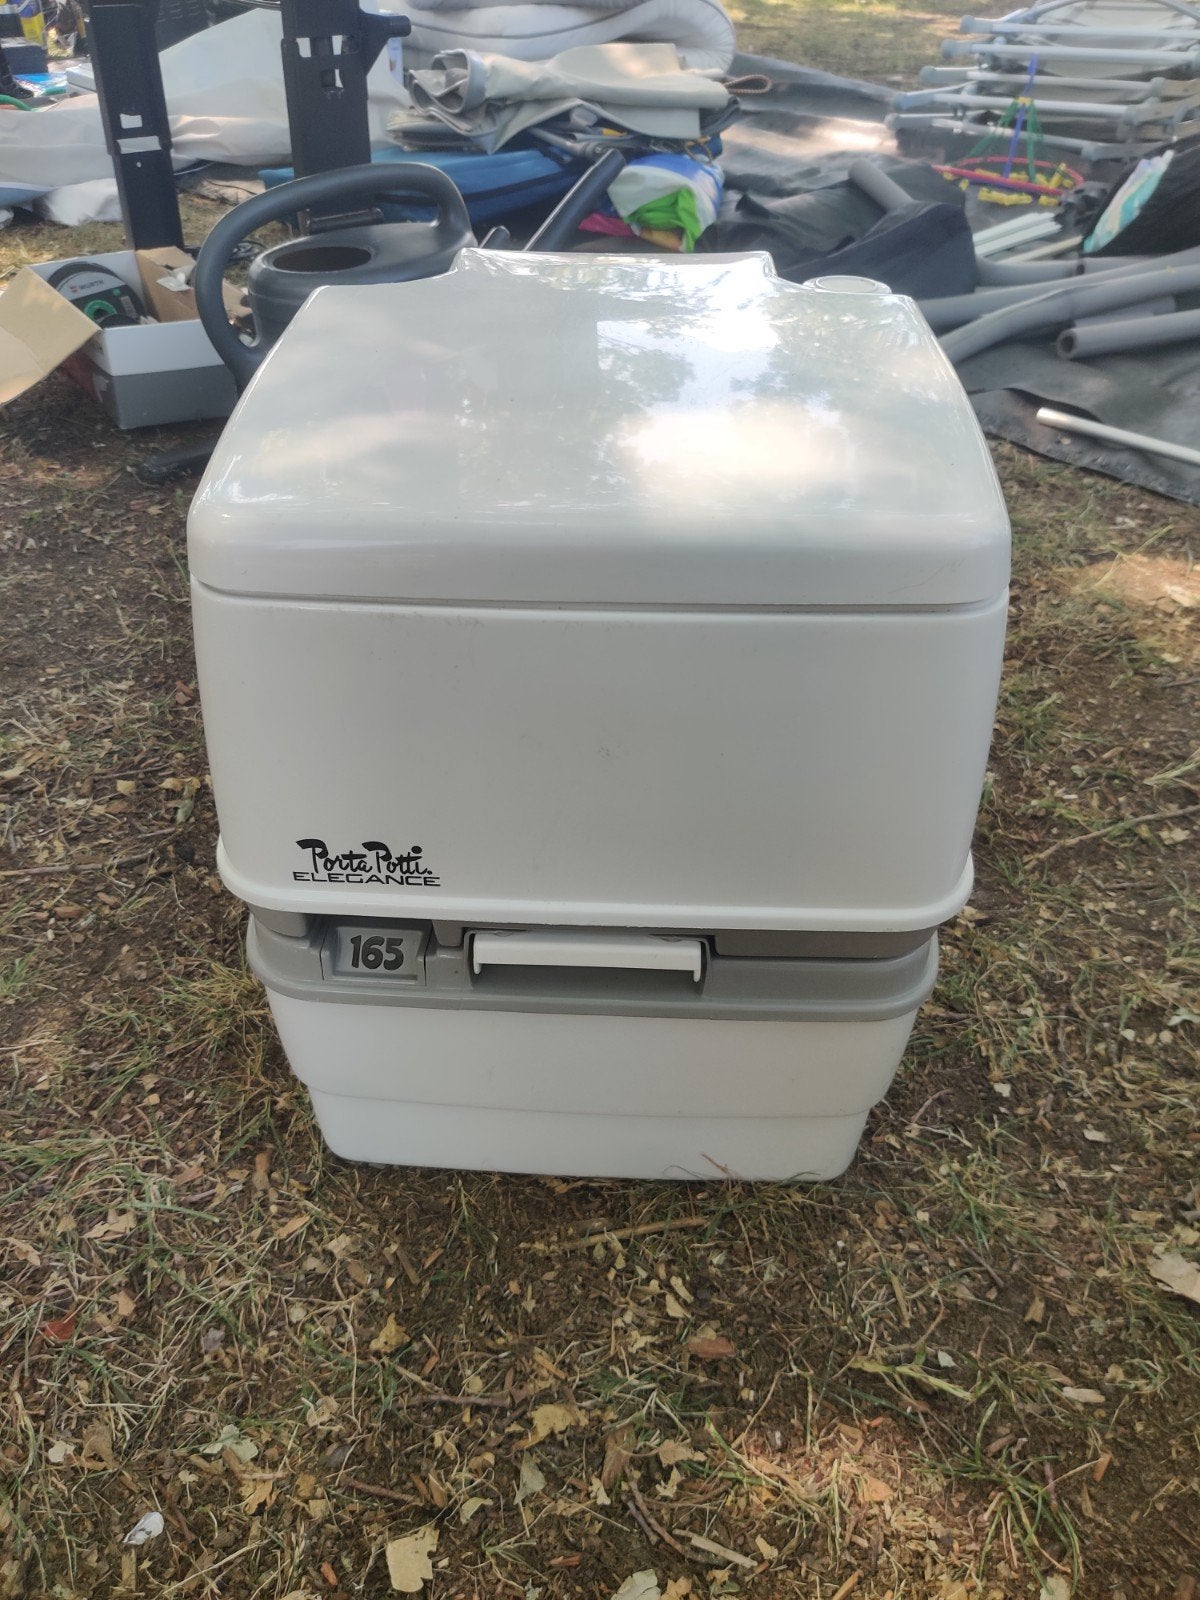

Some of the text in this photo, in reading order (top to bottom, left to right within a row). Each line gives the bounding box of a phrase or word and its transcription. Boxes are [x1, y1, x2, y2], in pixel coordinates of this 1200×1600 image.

[296, 838, 373, 873] Porta
[293, 871, 441, 887] ELEGANCE
[350, 934, 404, 971] 165
